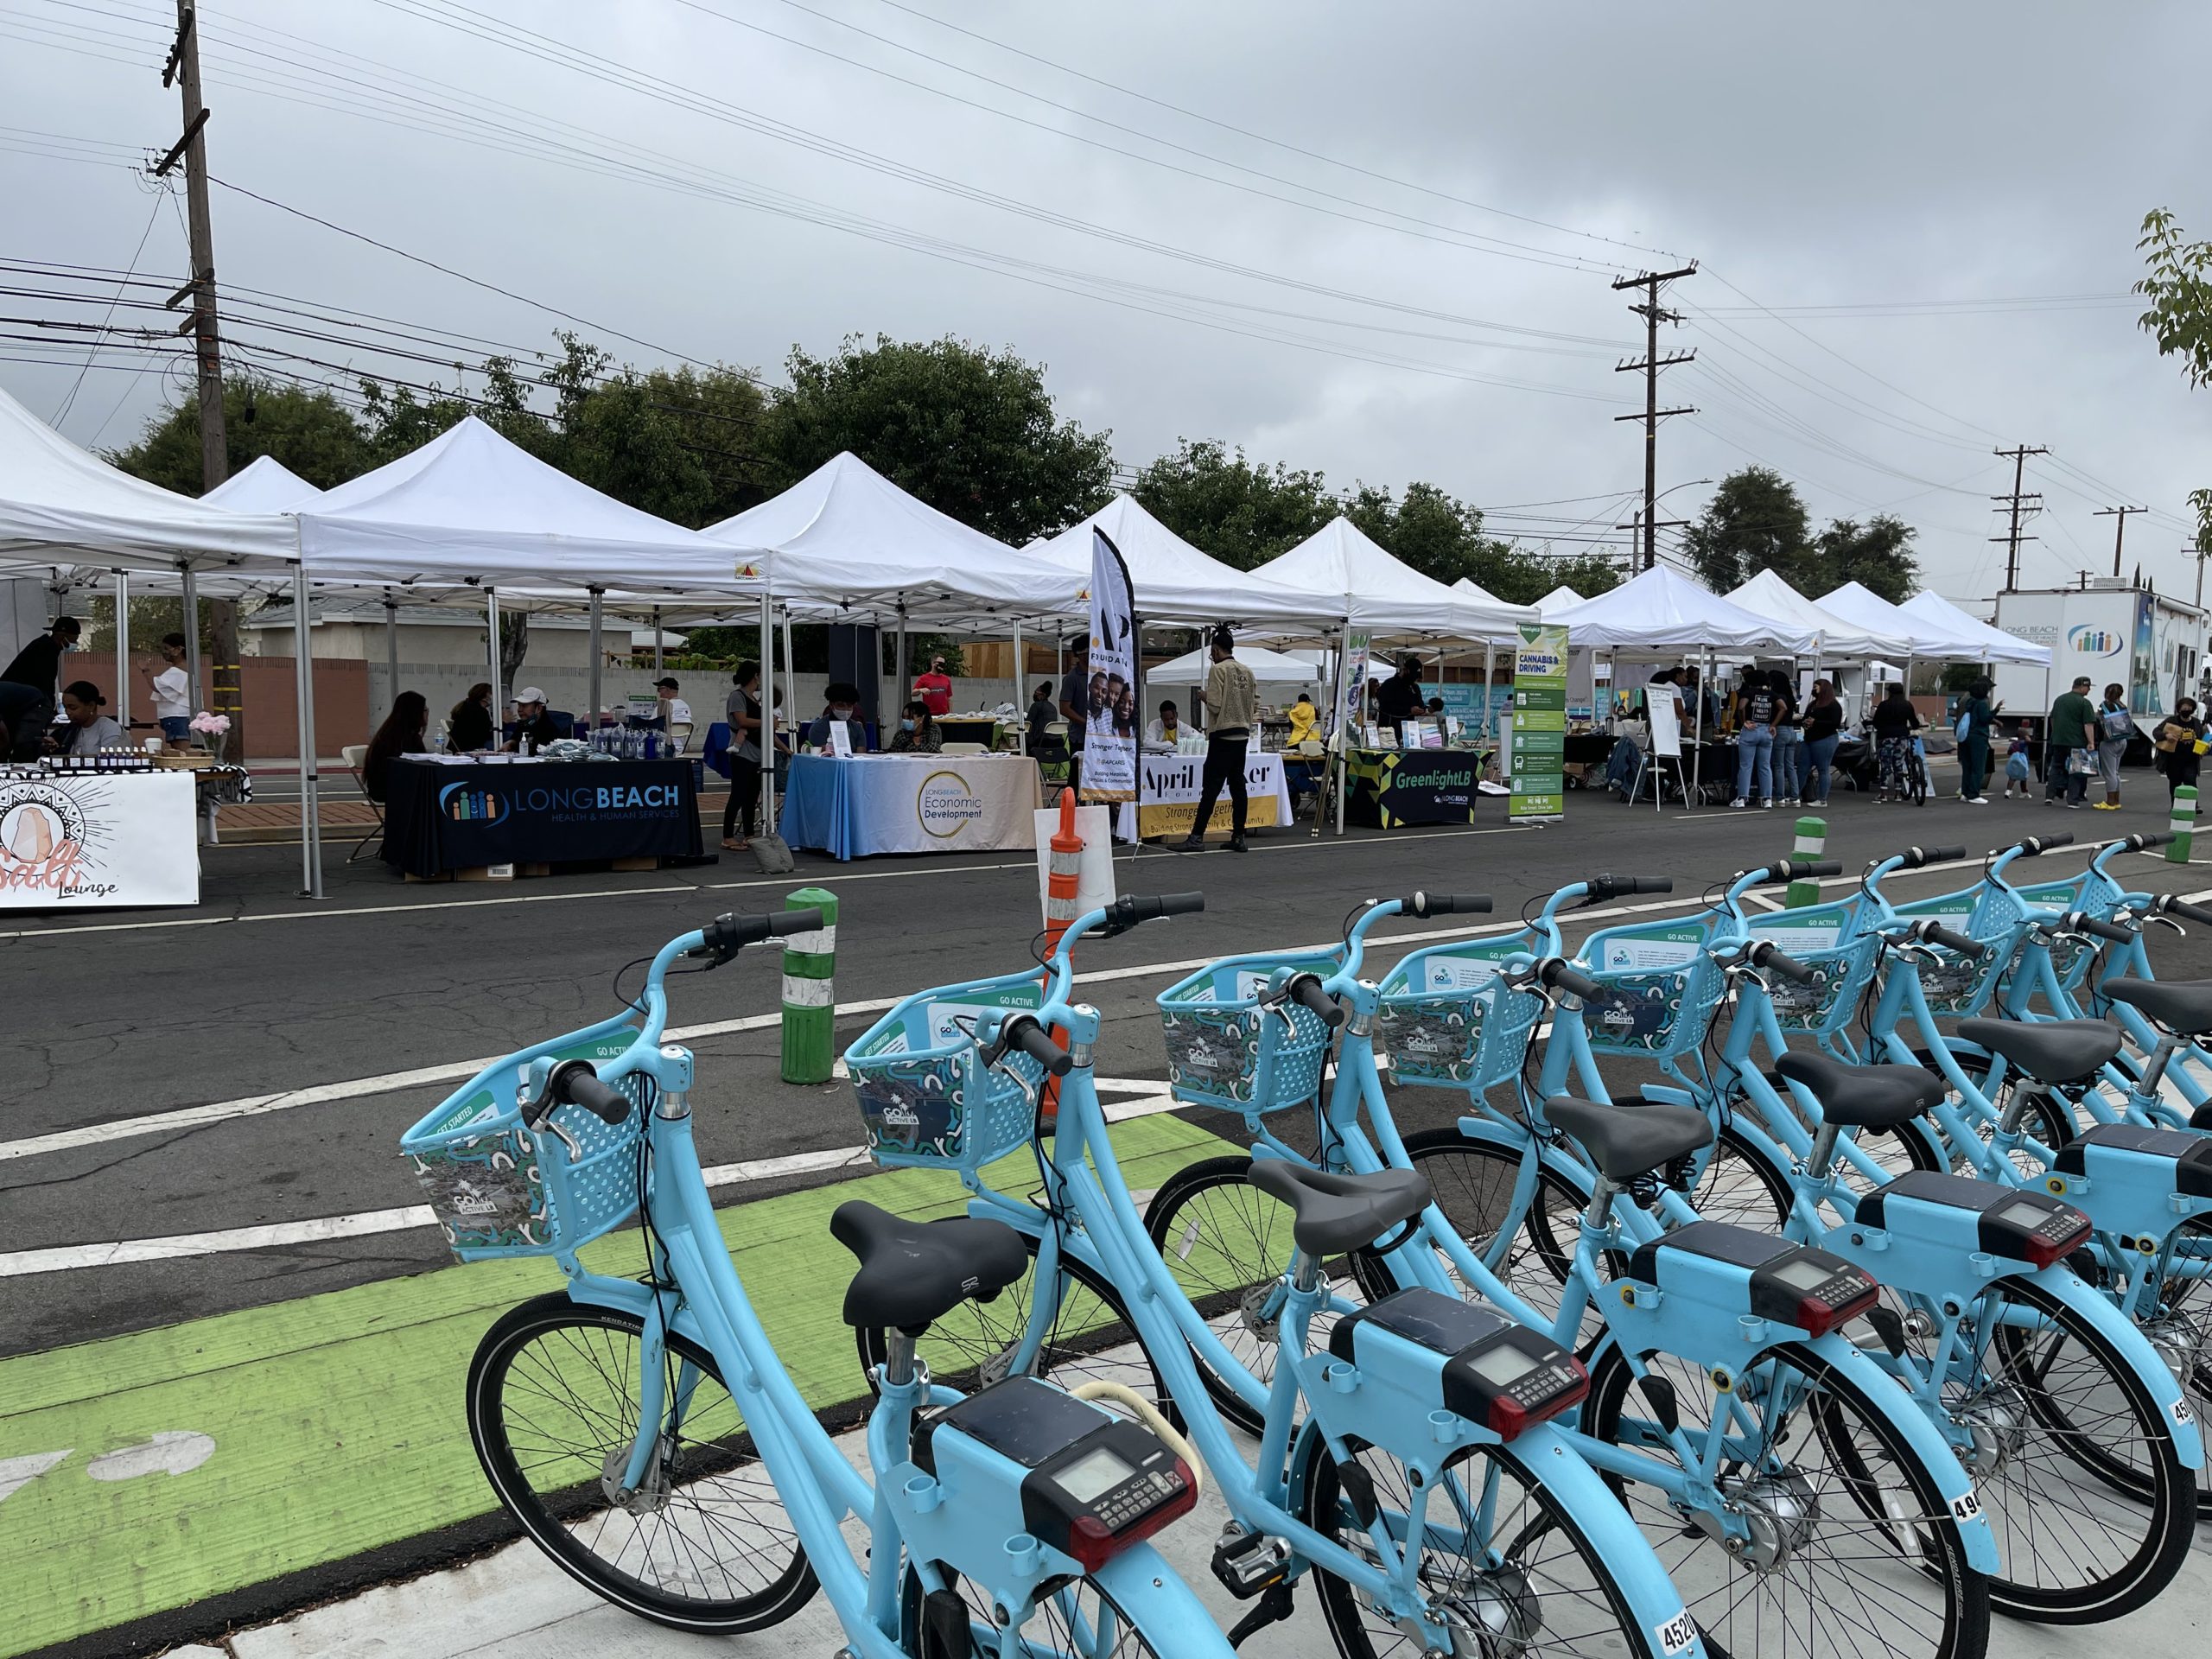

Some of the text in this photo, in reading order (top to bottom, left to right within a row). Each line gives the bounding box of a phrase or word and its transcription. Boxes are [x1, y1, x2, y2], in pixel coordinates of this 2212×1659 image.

[1519, 654, 1553, 664] CANNABIS
[1519, 664, 1547, 673] DRIVING
[1142, 765, 1193, 798] April
[1396, 770, 1471, 790] GreenlightLB
[925, 797, 982, 808] Economic
[552, 813, 587, 822] HEALTH
[601, 810, 636, 820] HUMAN
[639, 809, 679, 819] SERVICES
[925, 810, 982, 819] Development
[1166, 805, 1198, 819] Stronge
[1151, 824, 1173, 833] Building
[1221, 818, 1226, 827] &
[57, 881, 119, 899] Lounge
[1183, 984, 1199, 999] STARTED
[1011, 997, 1033, 1007] ACTIVE
[1604, 1010, 1620, 1019] GO
[873, 1033, 890, 1051] STARTED
[597, 1047, 607, 1056] GO
[1188, 1048, 1204, 1057] GO
[448, 1105, 473, 1131] STARTED
[883, 1107, 901, 1117] GO
[454, 1196, 475, 1206] GO
[1664, 1612, 1694, 1649] 4520
